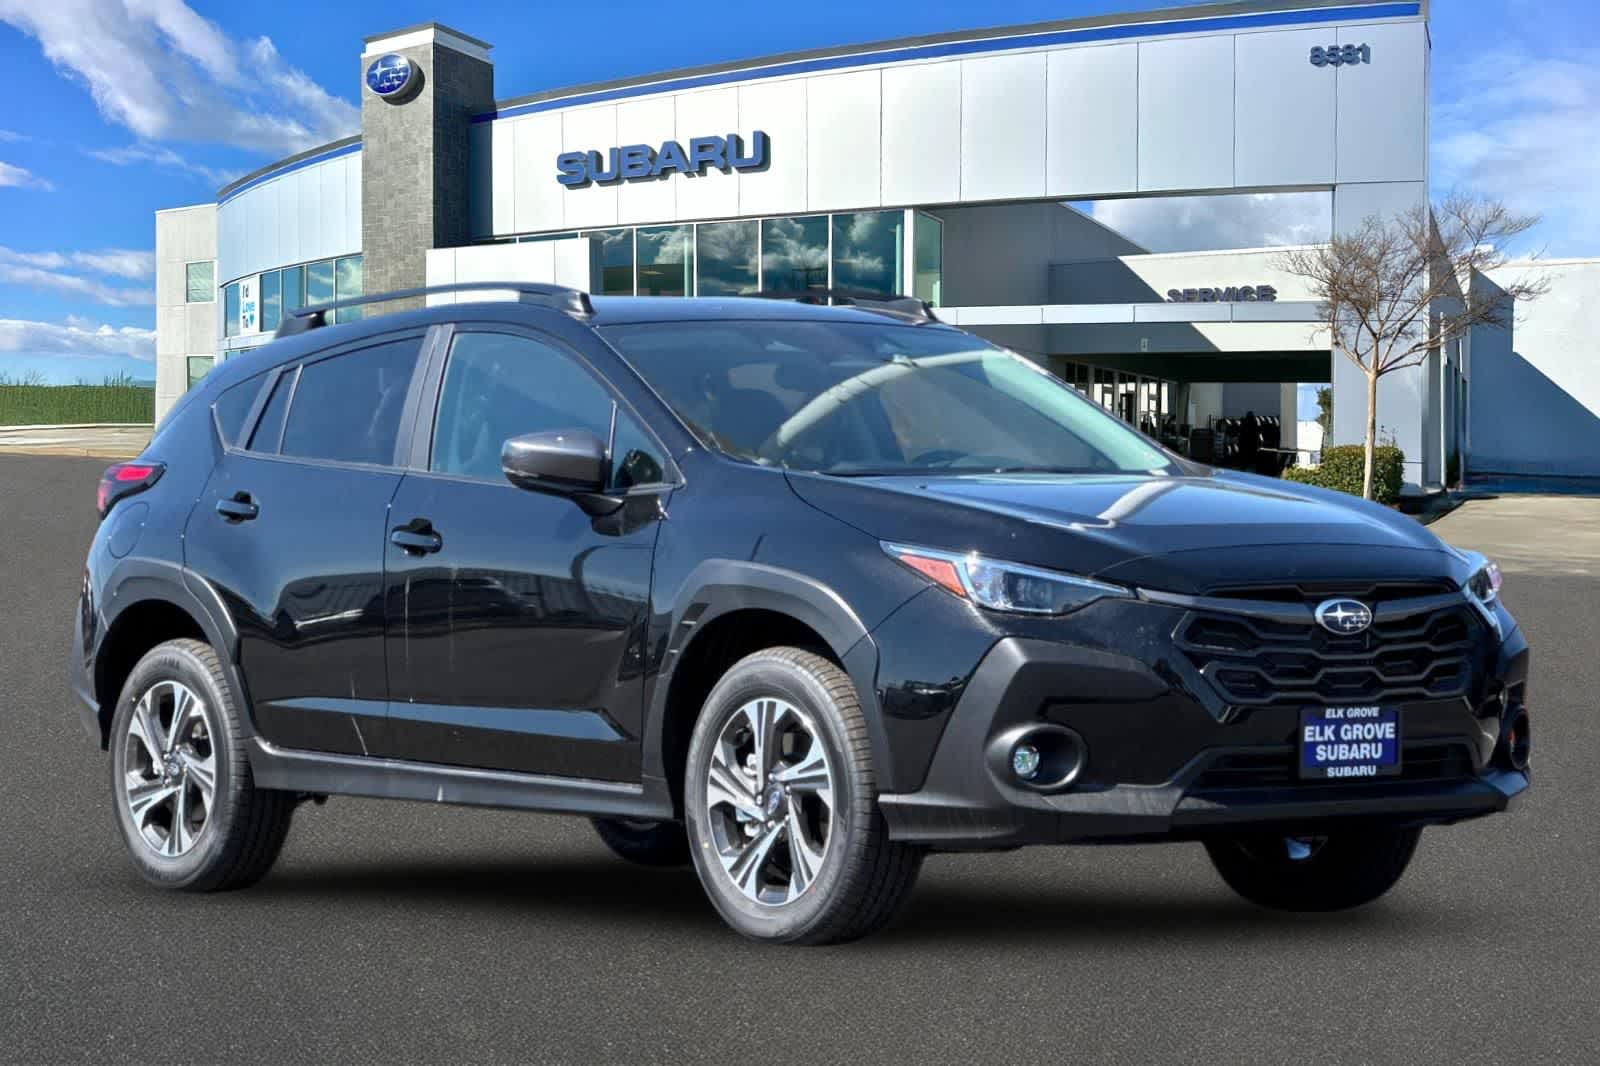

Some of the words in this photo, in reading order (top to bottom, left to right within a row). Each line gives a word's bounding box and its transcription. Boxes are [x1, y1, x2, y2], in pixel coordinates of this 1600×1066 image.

[556, 130, 771, 190] SUBARU
[1167, 285, 1277, 302] SERVICE
[1325, 708, 1344, 719] ELK
[1346, 707, 1380, 718] GROVE
[1304, 725, 1336, 742] ELK
[1340, 722, 1396, 741] GROVE
[1315, 742, 1383, 761] SUBARU
[1327, 765, 1377, 777] SUBARU
